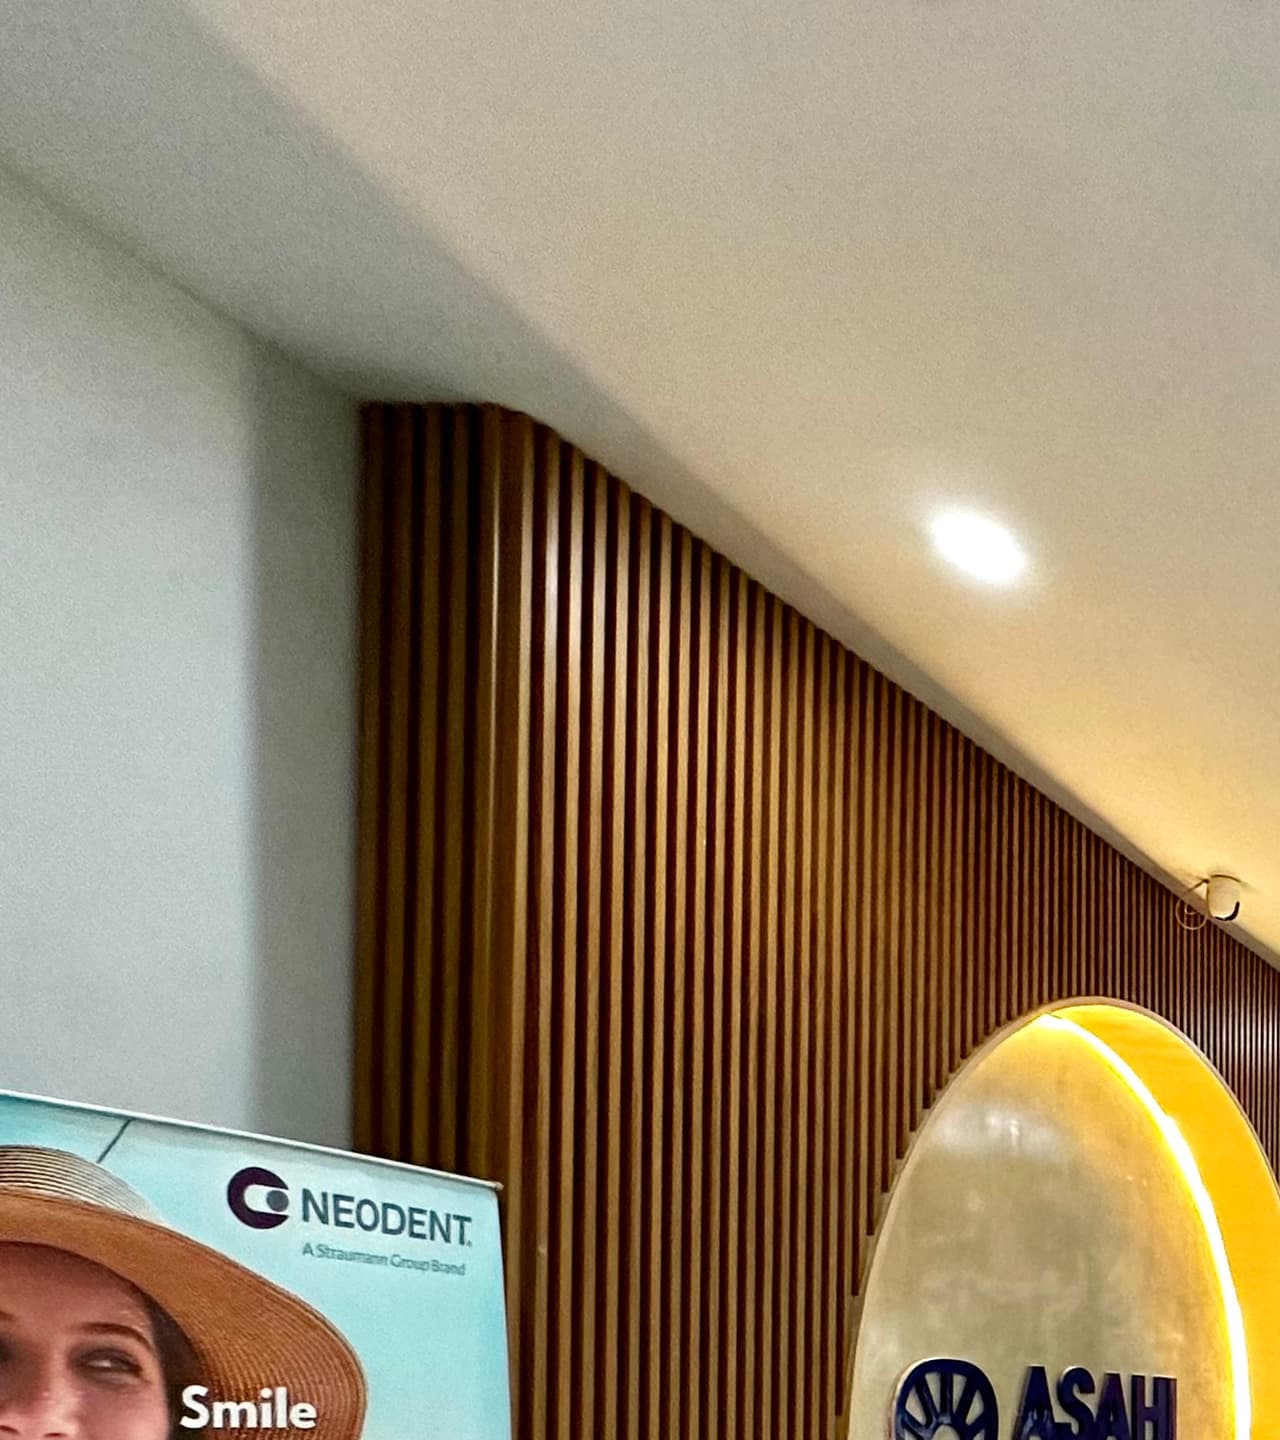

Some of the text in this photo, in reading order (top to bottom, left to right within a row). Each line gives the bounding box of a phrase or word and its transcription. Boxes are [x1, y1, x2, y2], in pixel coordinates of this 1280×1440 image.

[302, 1242, 466, 1276] A Straumann Group Brand
[180, 1385, 317, 1429] Smile
